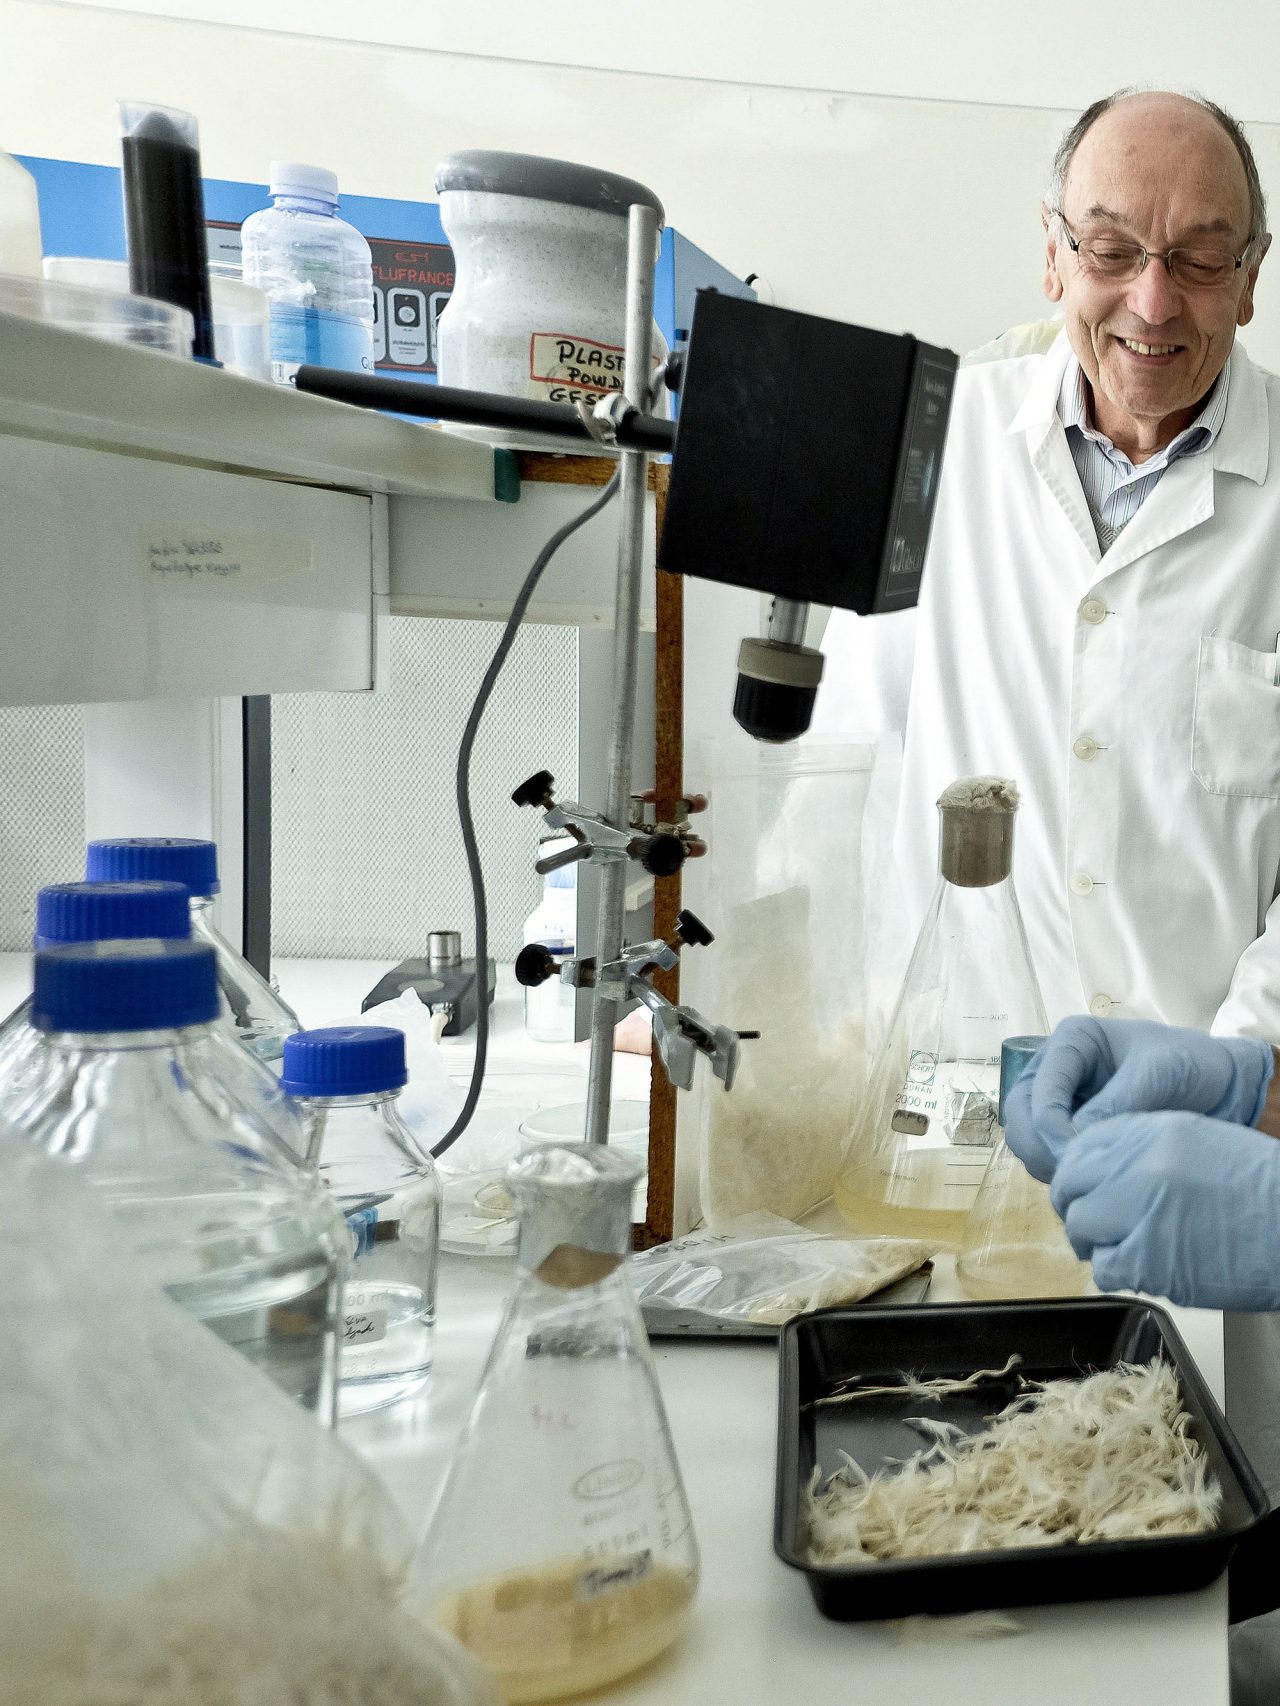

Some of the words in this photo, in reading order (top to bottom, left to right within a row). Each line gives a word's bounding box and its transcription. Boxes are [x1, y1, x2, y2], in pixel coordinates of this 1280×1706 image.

[371, 265, 455, 287] FLUFRANCE
[555, 340, 626, 372] PLAST
[566, 366, 625, 389] POWD
[903, 1083, 933, 1094] DURAN
[895, 1093, 921, 1107] 2000
[924, 1099, 938, 1110] ml
